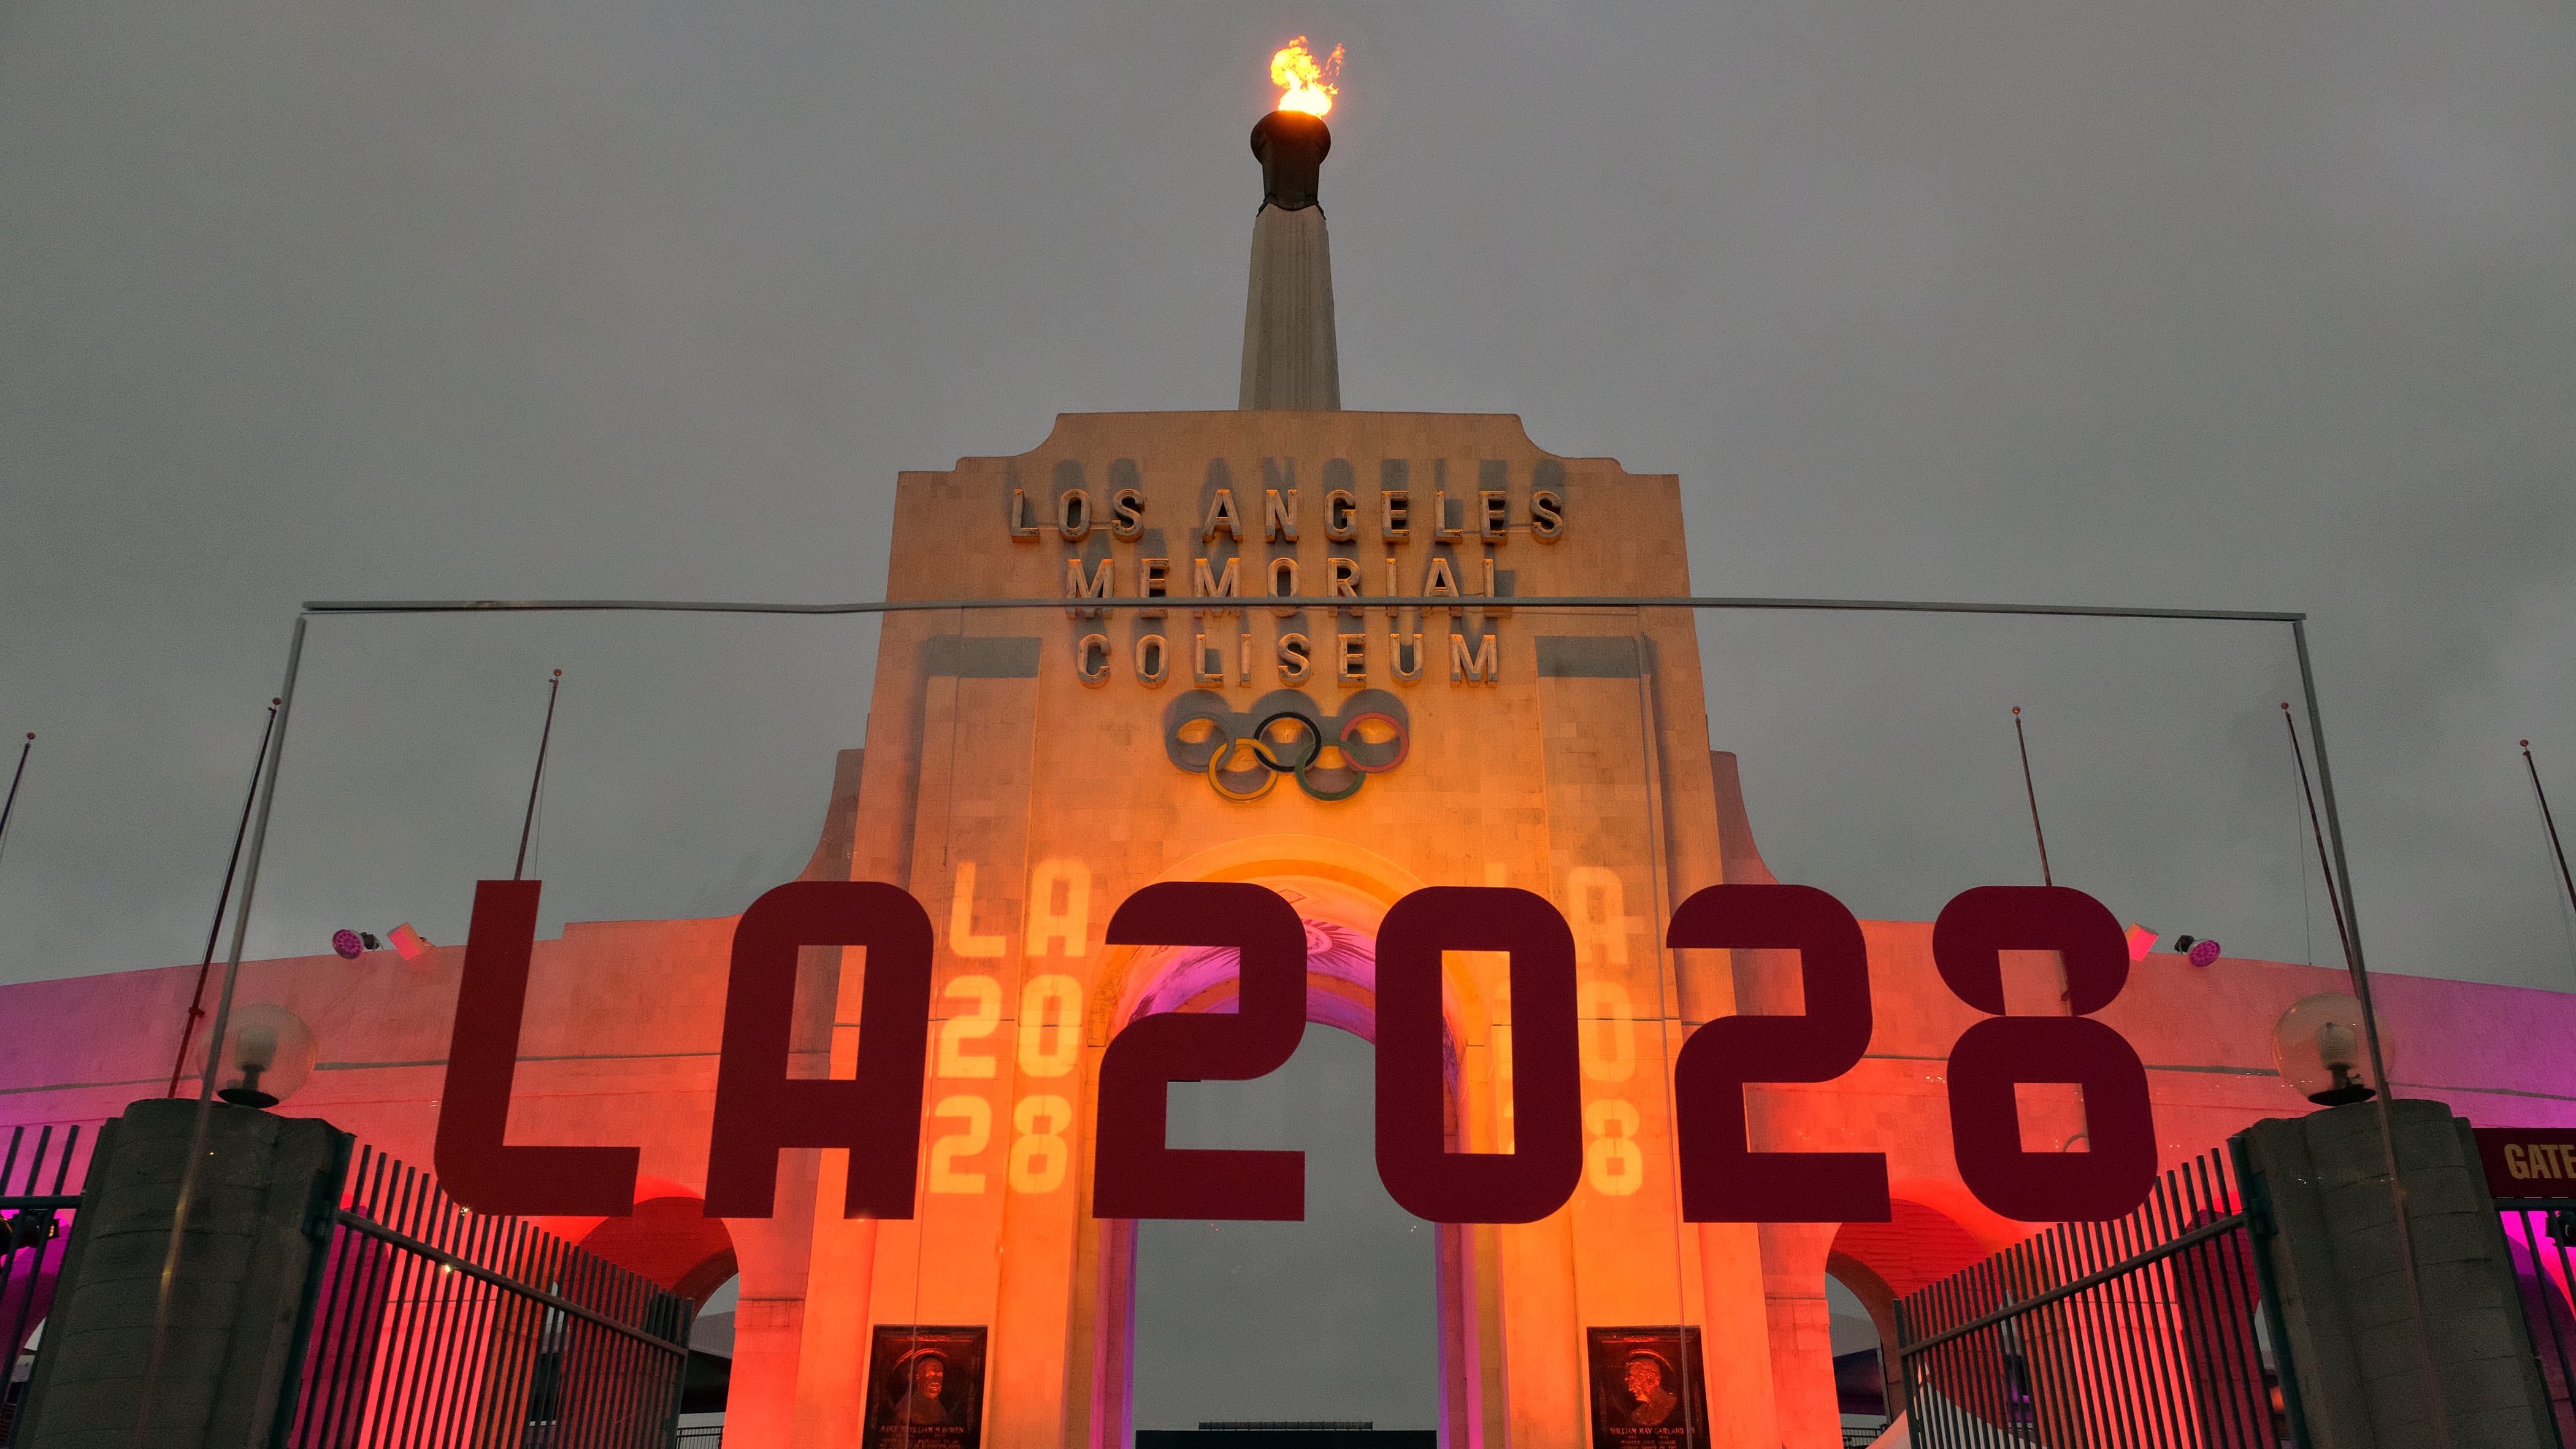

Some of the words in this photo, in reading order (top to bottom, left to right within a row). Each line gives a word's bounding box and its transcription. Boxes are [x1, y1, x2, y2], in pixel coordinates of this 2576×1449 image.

[1011, 488, 1145, 544] LOS
[1202, 488, 1565, 545] ANGELES
[1066, 557, 1512, 618] MEMORIAL
[1077, 633, 1498, 689] COLISEUM
[949, 858, 1091, 957] LA
[434, 880, 934, 1220] LA
[1092, 881, 2158, 1224] 2028
[938, 974, 1083, 1078] 20
[929, 1095, 1072, 1194] 28
[2504, 1143, 2576, 1180] GATE
